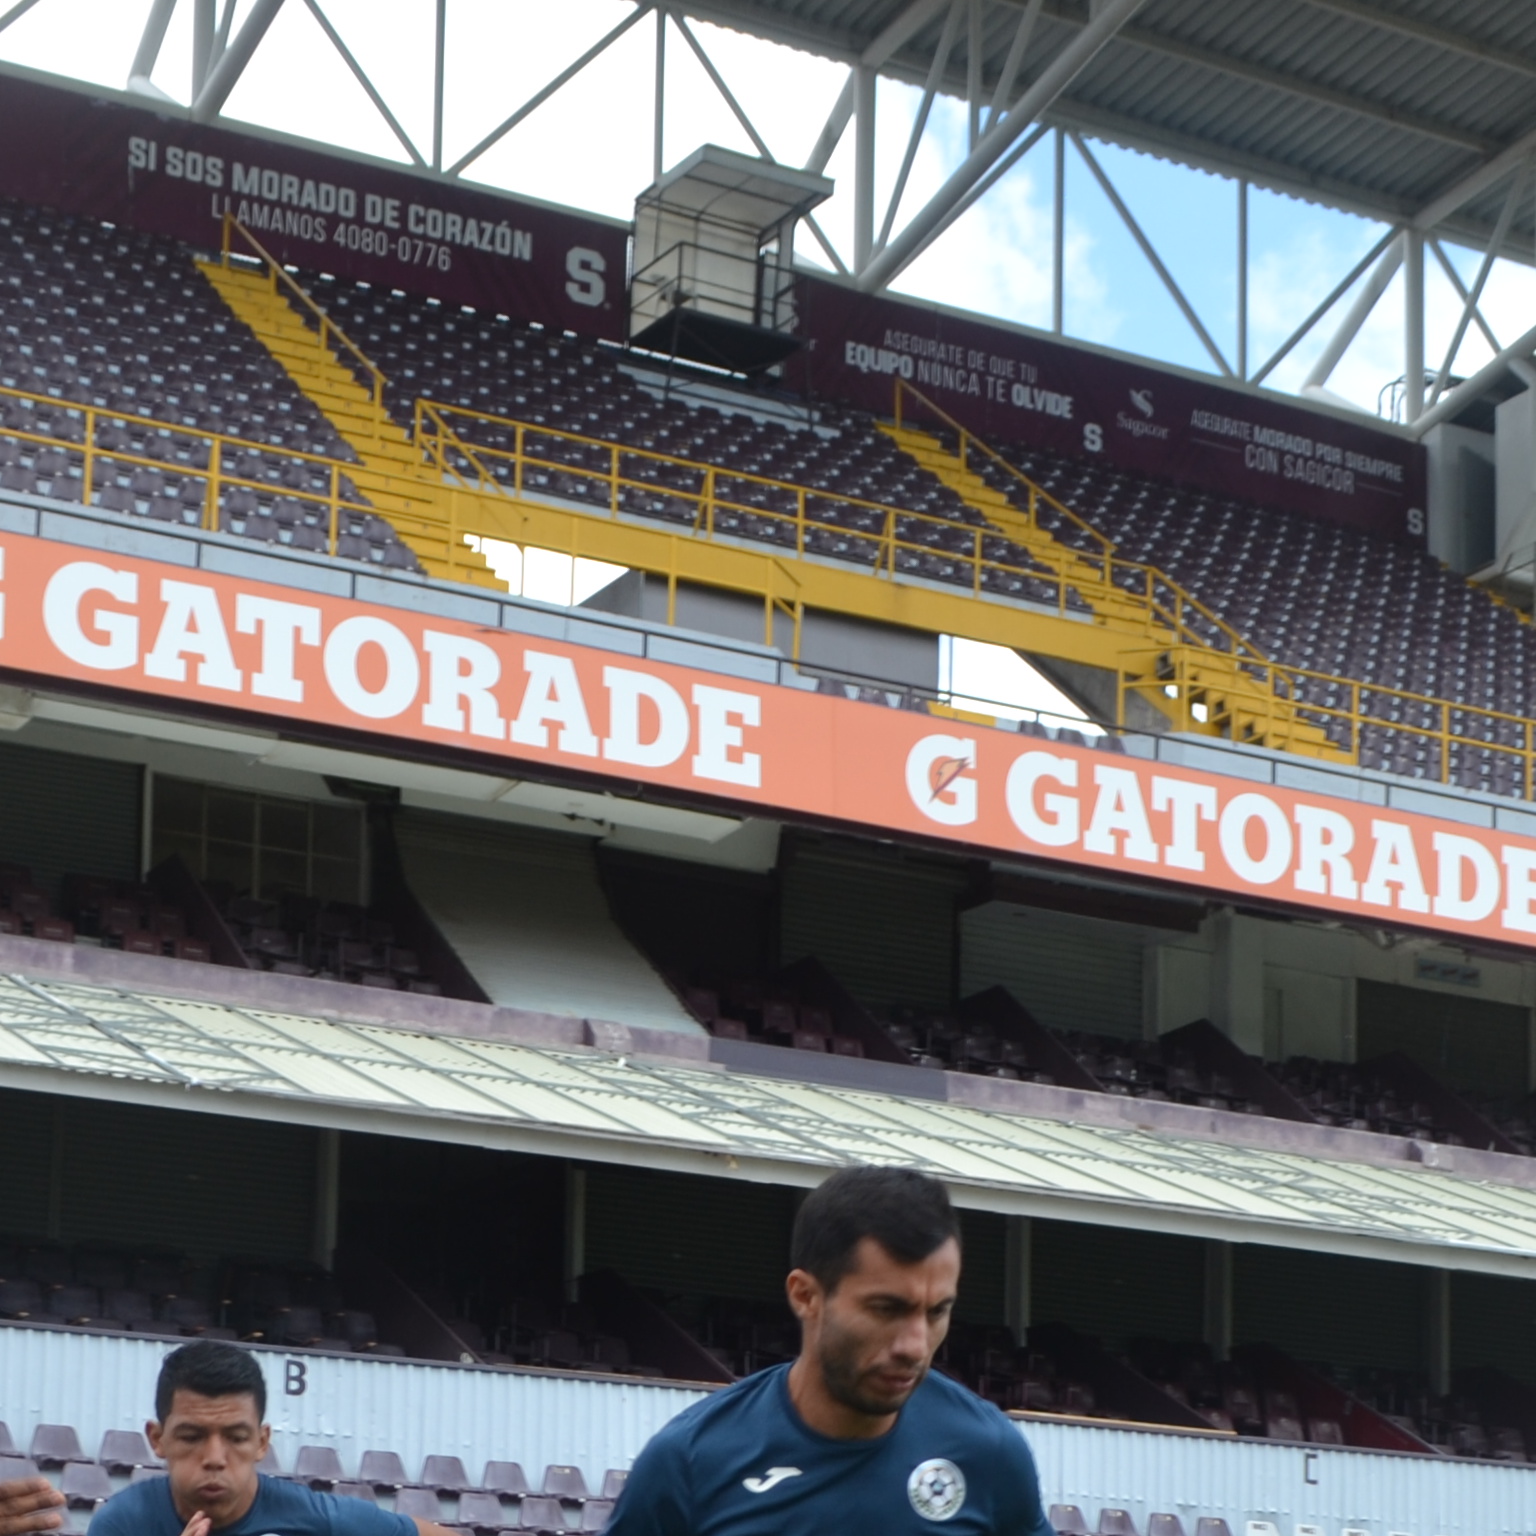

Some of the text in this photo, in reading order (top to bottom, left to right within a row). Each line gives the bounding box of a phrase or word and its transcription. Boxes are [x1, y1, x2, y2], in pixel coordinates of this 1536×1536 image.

[128, 136, 533, 262] SI SOS MORADO DE CORAZÓN
[333, 222, 452, 273] 4080-0776
[565, 246, 607, 307] S
[845, 340, 1074, 420] EQUIPO NUNCA TE OLVIDE
[883, 328, 1039, 384] ASEGURATE DE QUE TU
[1082, 422, 1104, 452] S
[1315, 442, 1343, 465] POR
[1344, 449, 1404, 483] SIEMPRE
[1244, 443, 1356, 495] CON SAGICOR
[42, 560, 762, 789] GATORADE
[284, 1359, 308, 1396] B
